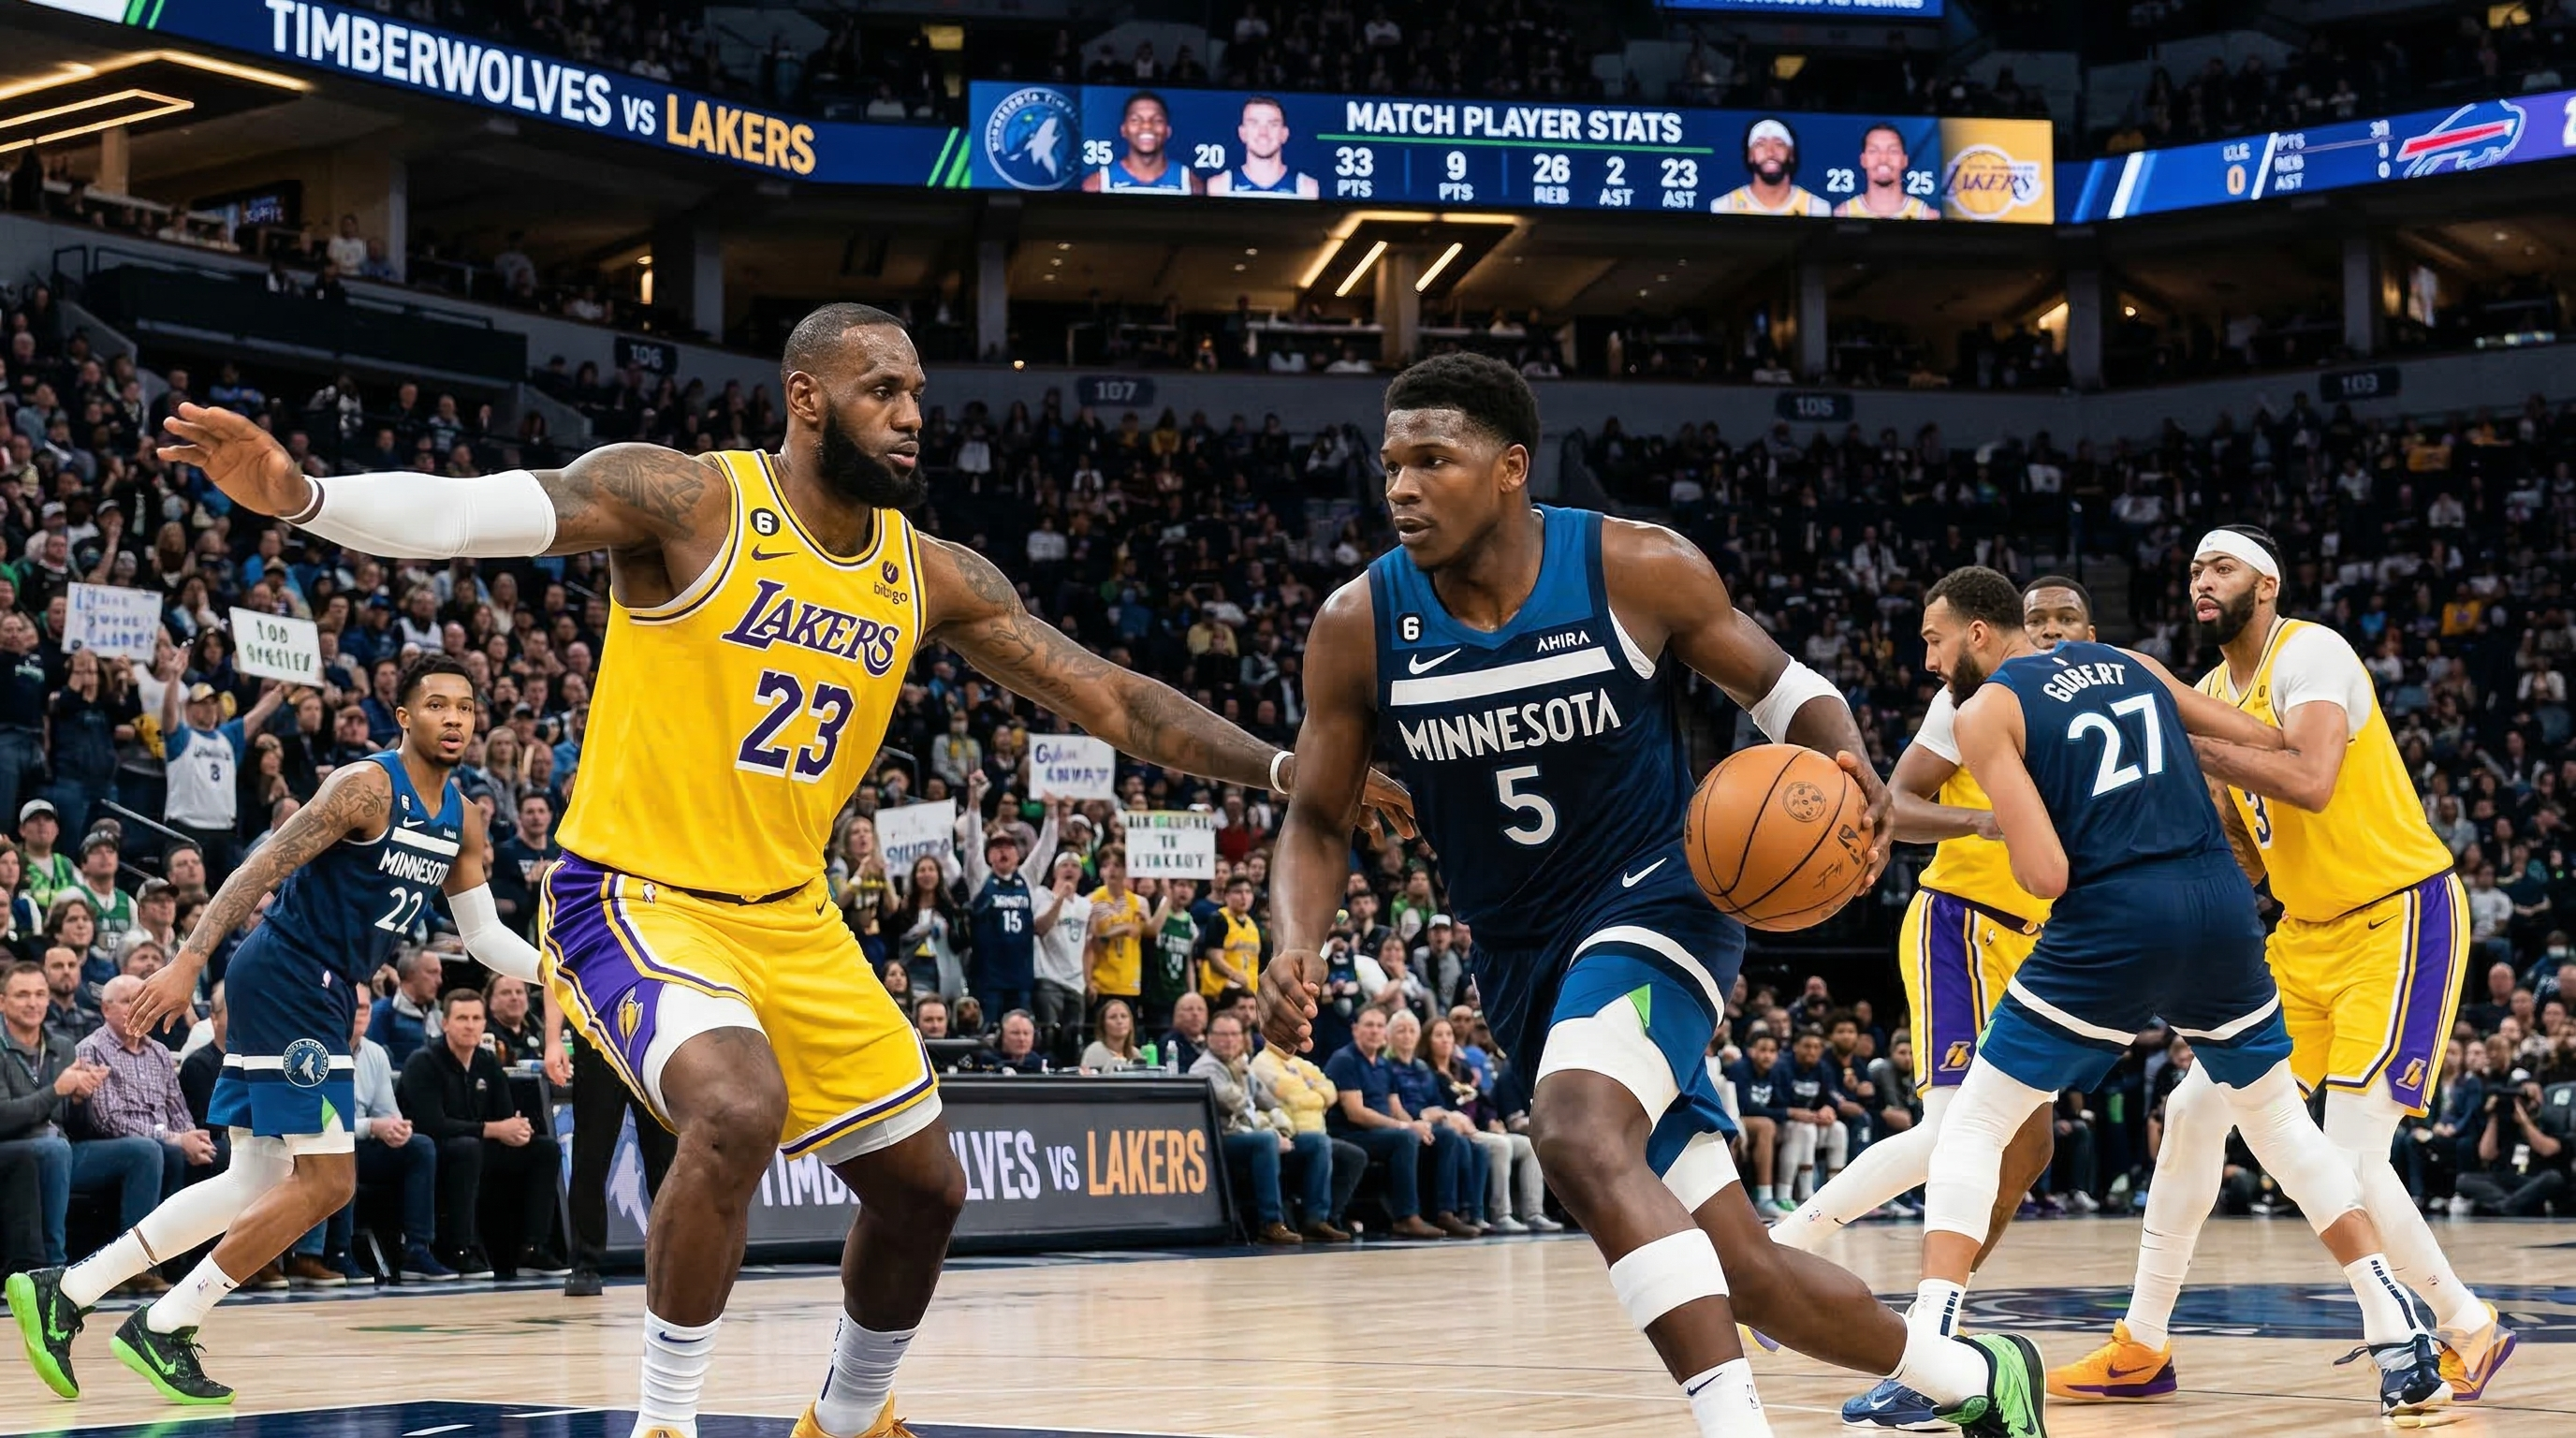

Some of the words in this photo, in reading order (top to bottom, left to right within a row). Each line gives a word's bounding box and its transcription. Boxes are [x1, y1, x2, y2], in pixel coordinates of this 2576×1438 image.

[266, 0, 612, 127] TIMBERWOLVES
[666, 94, 816, 175] LAKERS
[1346, 101, 1456, 136] MATCH
[1463, 106, 1582, 140] PLAYER
[1588, 110, 1683, 143] STATS
[1082, 139, 1114, 166] 35
[1194, 143, 1225, 169] 20
[1335, 146, 1374, 178] 33
[1446, 151, 1467, 181] 9
[1532, 153, 1571, 184] 26
[1605, 155, 1626, 185] 2
[1661, 158, 1698, 189] 23
[1826, 168, 1855, 193] 23
[1906, 170, 1935, 195] 25
[2227, 164, 2246, 196] 0
[1337, 179, 1373, 198] PTS
[1439, 183, 1474, 201] PTS
[1599, 188, 1634, 207] AST
[1661, 189, 1697, 209] AST
[1094, 380, 1138, 402] 107
[756, 512, 773, 534] 6
[720, 579, 900, 677] LAKERS
[1403, 616, 1420, 641] 6
[1537, 630, 1591, 653] AHIRA
[2042, 663, 2126, 703] GOBERT
[734, 668, 856, 785] 23
[1398, 688, 1621, 761] MINNESOTA
[2067, 693, 2163, 798] 27
[1496, 765, 1557, 845] 5
[374, 887, 423, 935] 22
[1088, 1128, 1207, 1196] LAKERS
